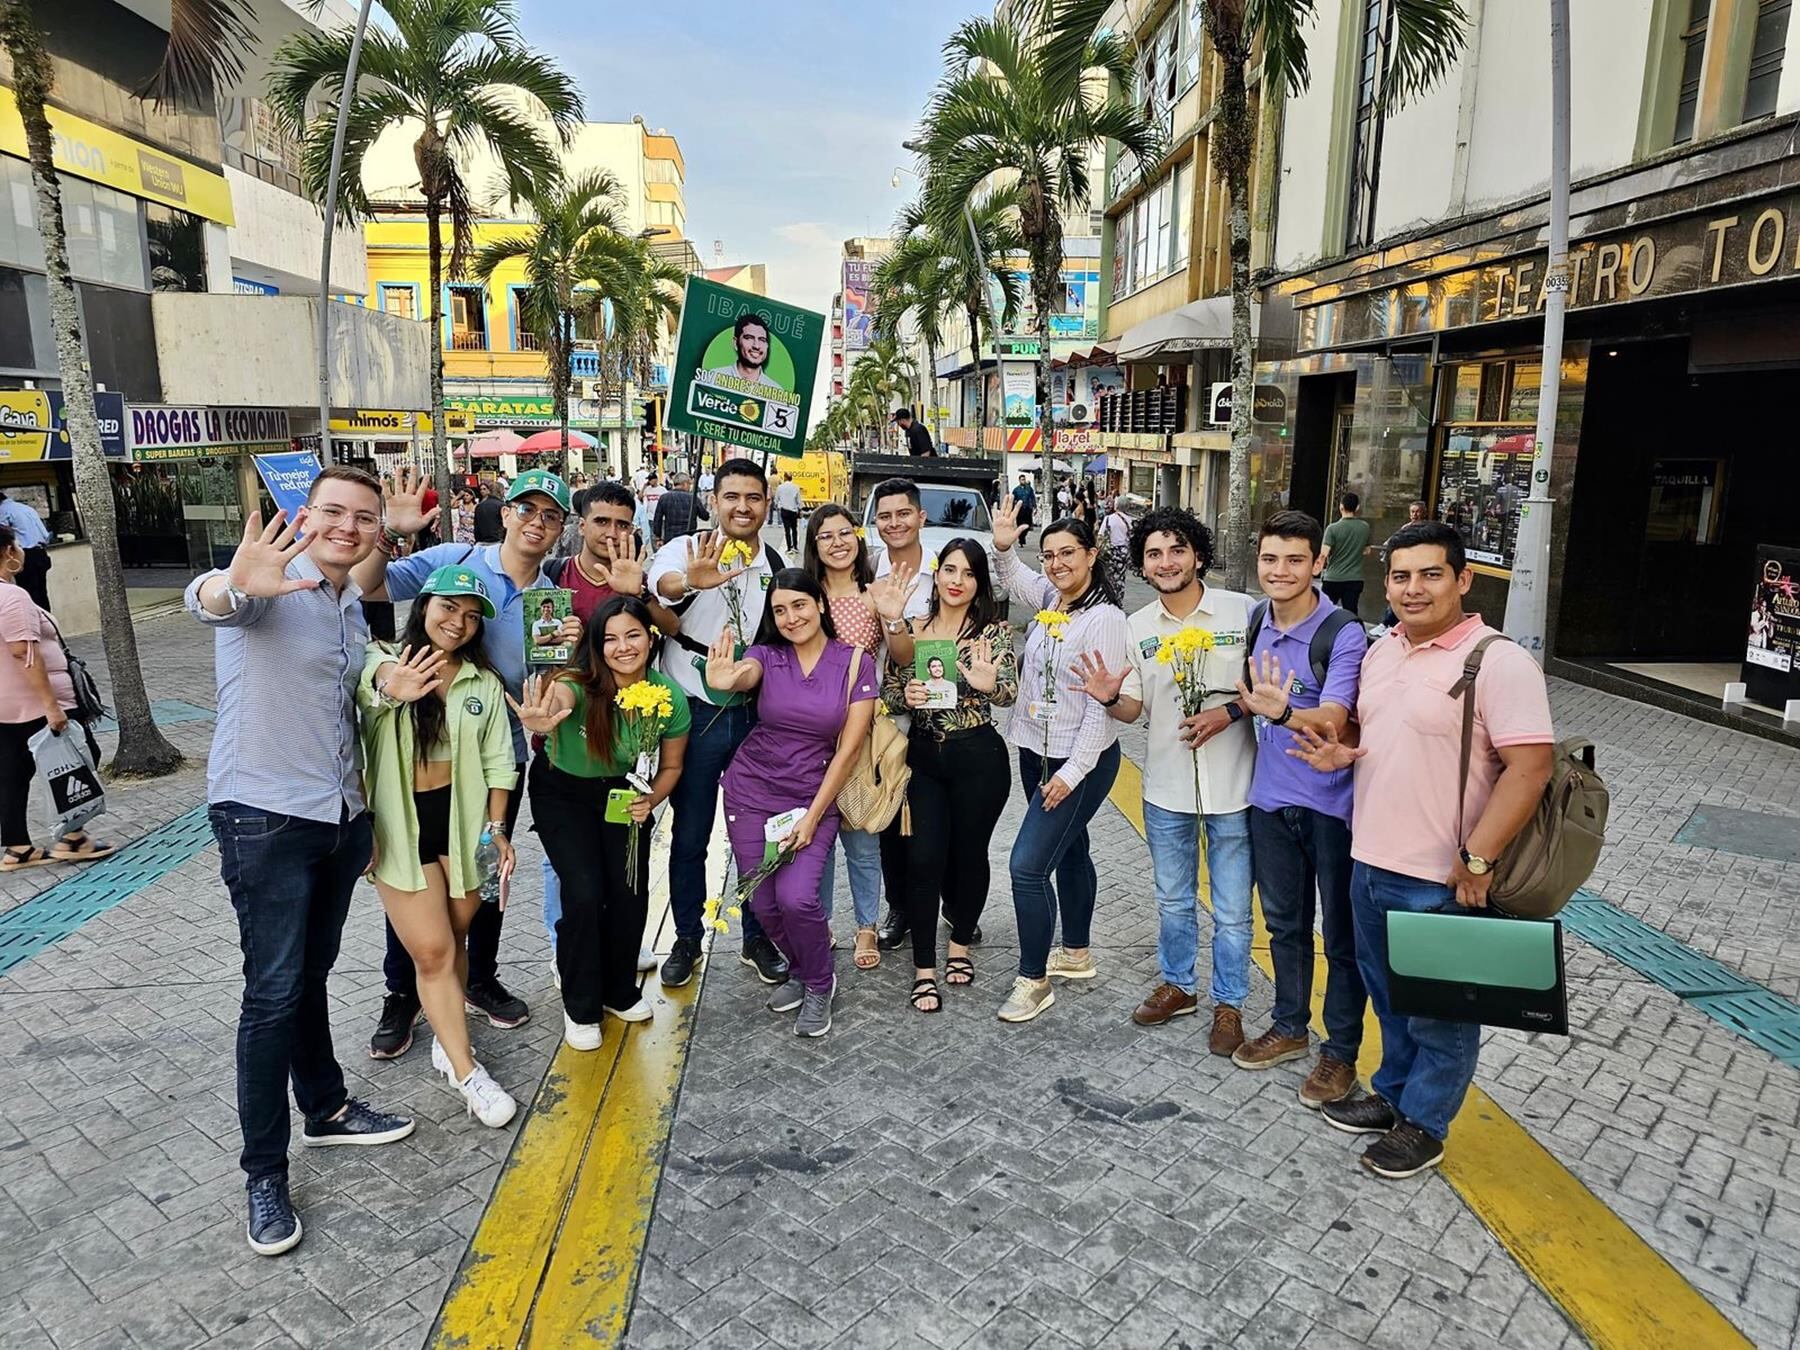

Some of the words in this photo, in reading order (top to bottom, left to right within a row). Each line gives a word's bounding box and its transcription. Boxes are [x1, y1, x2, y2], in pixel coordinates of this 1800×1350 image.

[1708, 207, 1800, 283] TO
[694, 367, 715, 385] SOY
[752, 382, 801, 407] ZAMBRANO
[450, 401, 554, 415] BARATAS
[697, 391, 738, 415] Verde
[348, 413, 399, 428] mimo's
[774, 408, 788, 428] 5
[132, 409, 201, 445] DROGAS
[205, 409, 223, 442] LA
[225, 409, 289, 442] ECONOMIA
[695, 420, 703, 432] Y
[703, 421, 726, 438] SERÉ
[728, 427, 740, 441] TU
[740, 431, 782, 452] CONCEJAL
[145, 449, 167, 460] SUPER
[168, 448, 195, 459] BARATAS
[546, 479, 556, 491] 5
[1654, 474, 1710, 486] TAQUILLA
[478, 582, 486, 596] 5
